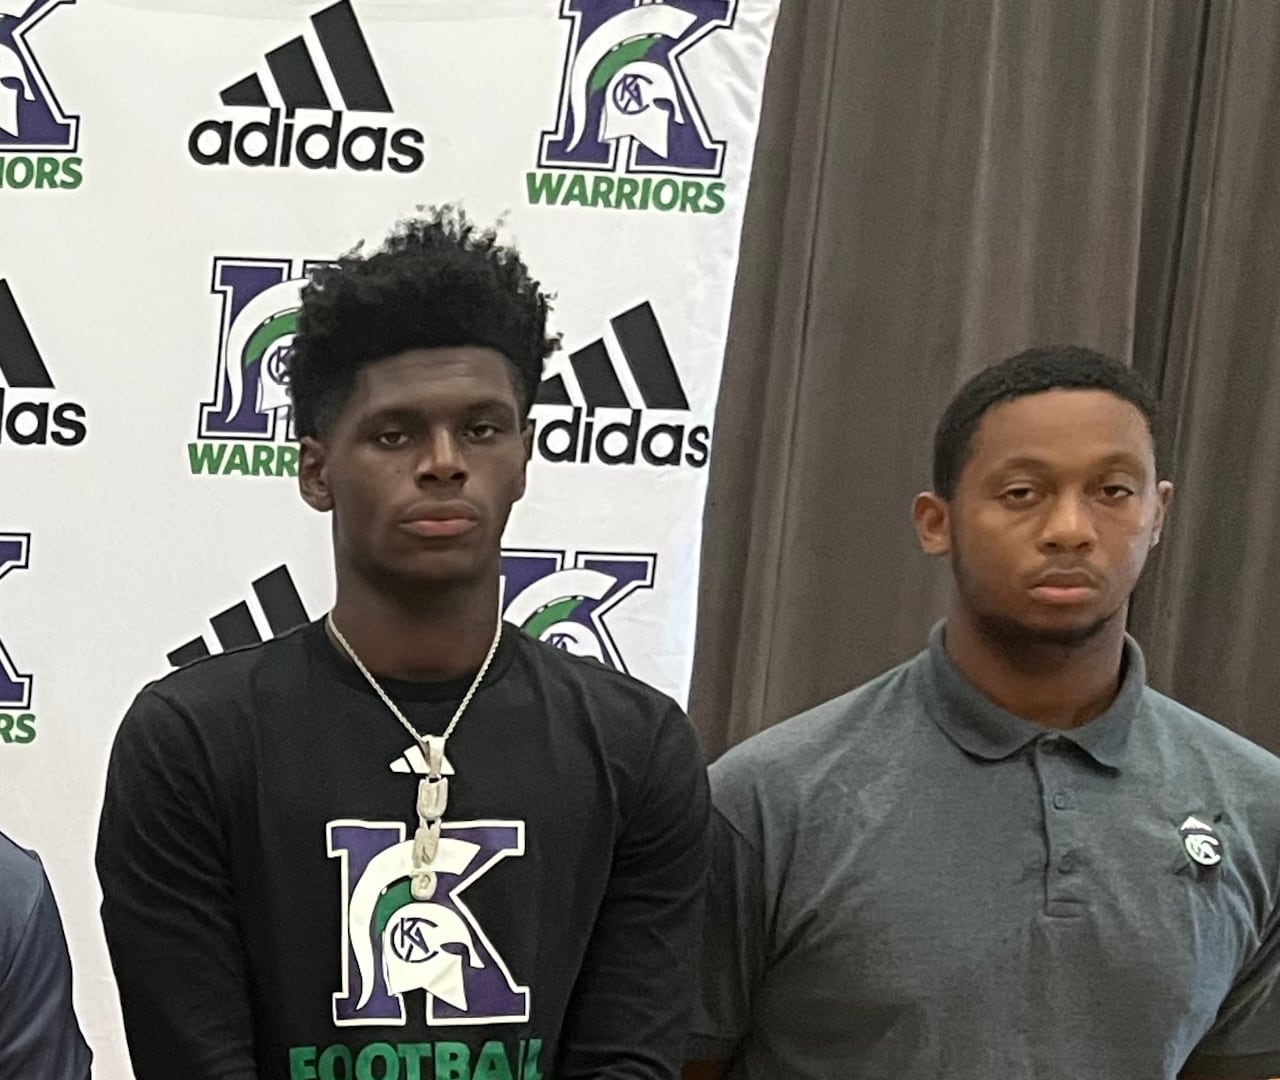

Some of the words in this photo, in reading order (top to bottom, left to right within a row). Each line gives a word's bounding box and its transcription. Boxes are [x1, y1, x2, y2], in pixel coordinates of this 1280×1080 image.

[187, 108, 425, 173] adidas
[526, 172, 726, 215] WARRIORS
[188, 443, 300, 477] WARR
[527, 407, 710, 468] didas
